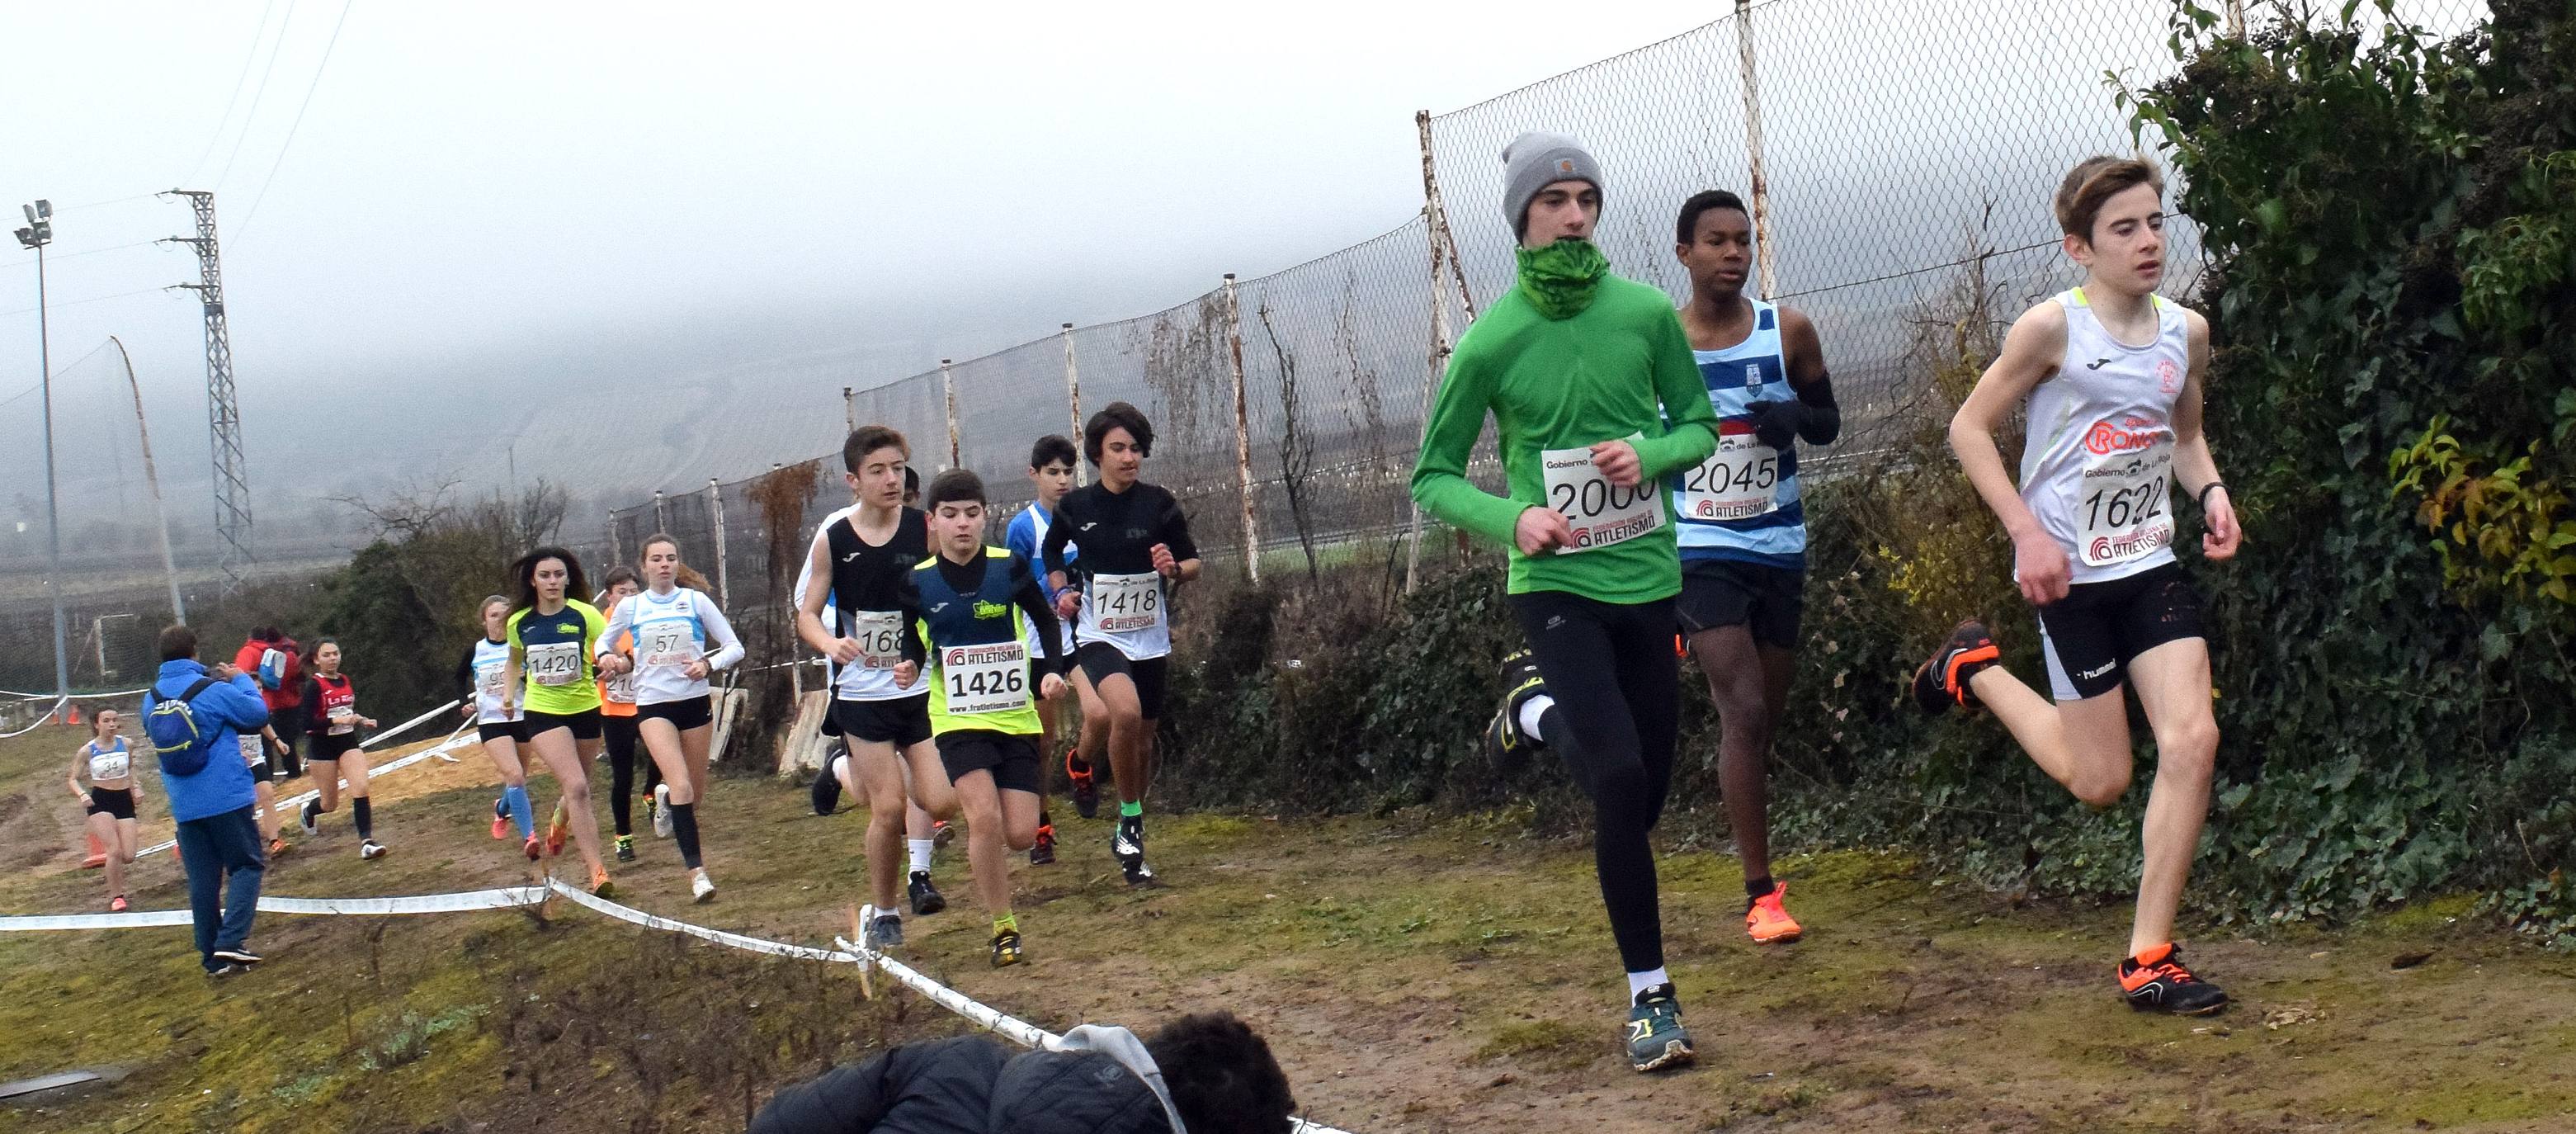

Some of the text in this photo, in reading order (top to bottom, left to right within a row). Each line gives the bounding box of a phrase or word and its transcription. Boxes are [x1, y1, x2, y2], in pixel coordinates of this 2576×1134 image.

[1546, 459, 1588, 470] Gobierno
[2085, 468, 2125, 479] Gobierno
[1687, 456, 1776, 494] 2045
[1716, 501, 1768, 517] ATLETISMO
[2085, 475, 2164, 532] 1622
[1594, 515, 1656, 546] ATLETISMO
[2113, 528, 2171, 558] ATLETISMO
[1097, 588, 1157, 614] 1418
[1115, 617, 1155, 630] ATLETISMO
[655, 634, 679, 653] 57
[532, 654, 578, 673] 1420
[968, 649, 1024, 666] ATLETISMO
[951, 668, 1023, 697] 1426
